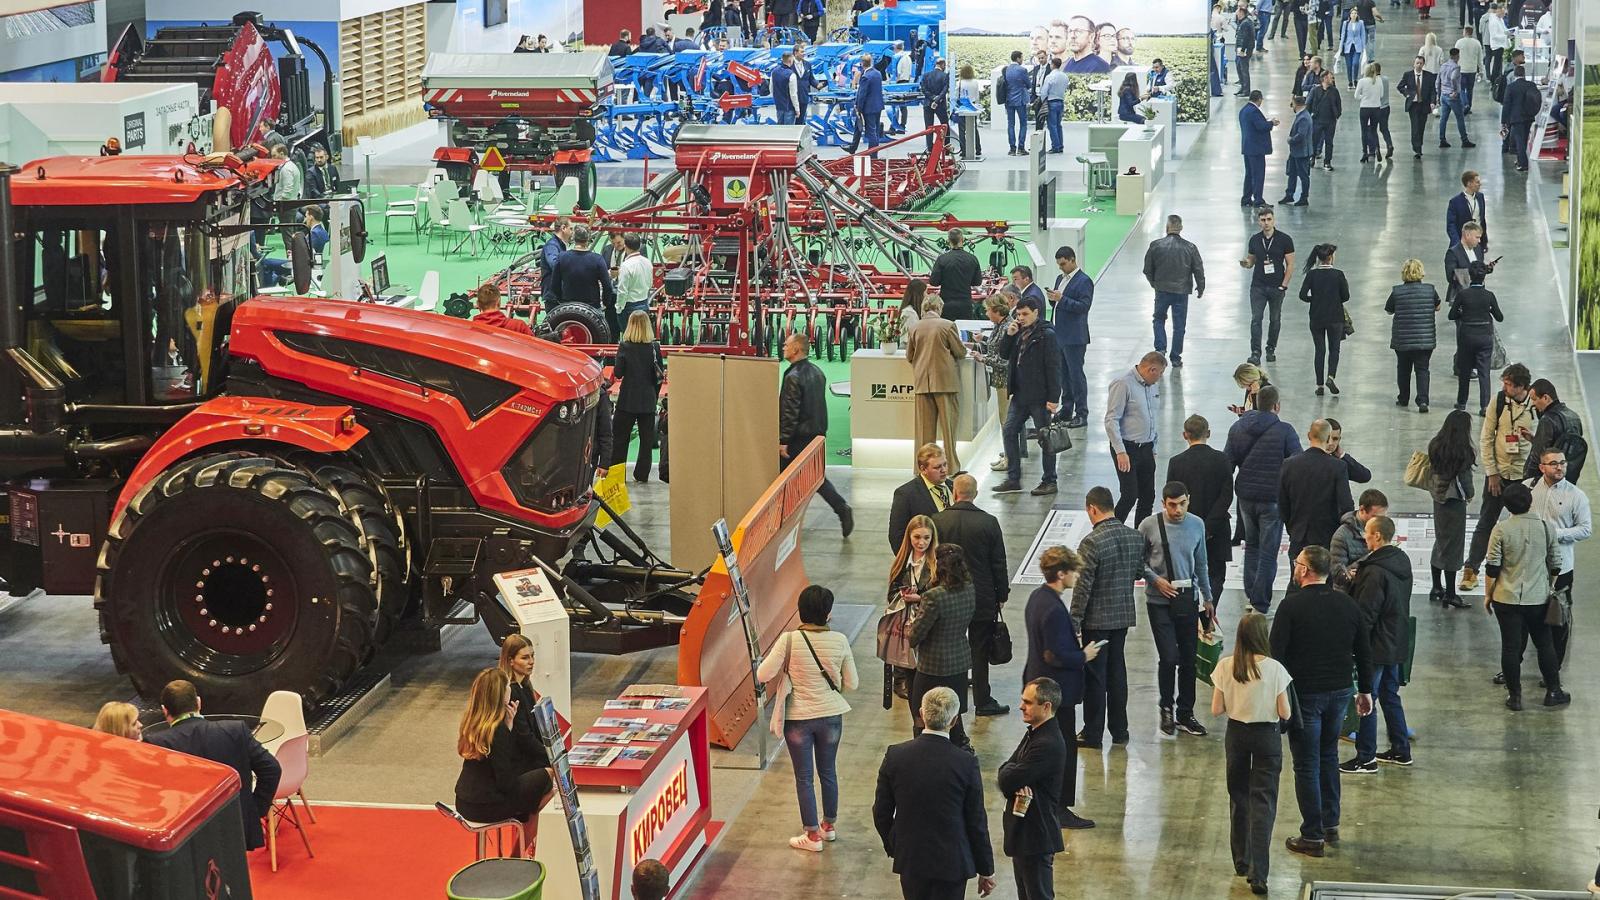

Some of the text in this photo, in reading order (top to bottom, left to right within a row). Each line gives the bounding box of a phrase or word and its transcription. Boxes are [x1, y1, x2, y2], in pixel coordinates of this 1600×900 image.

[127, 128, 144, 143] PARTS
[891, 384, 914, 394] АГР
[634, 759, 688, 866] КИРОВЕЦ
